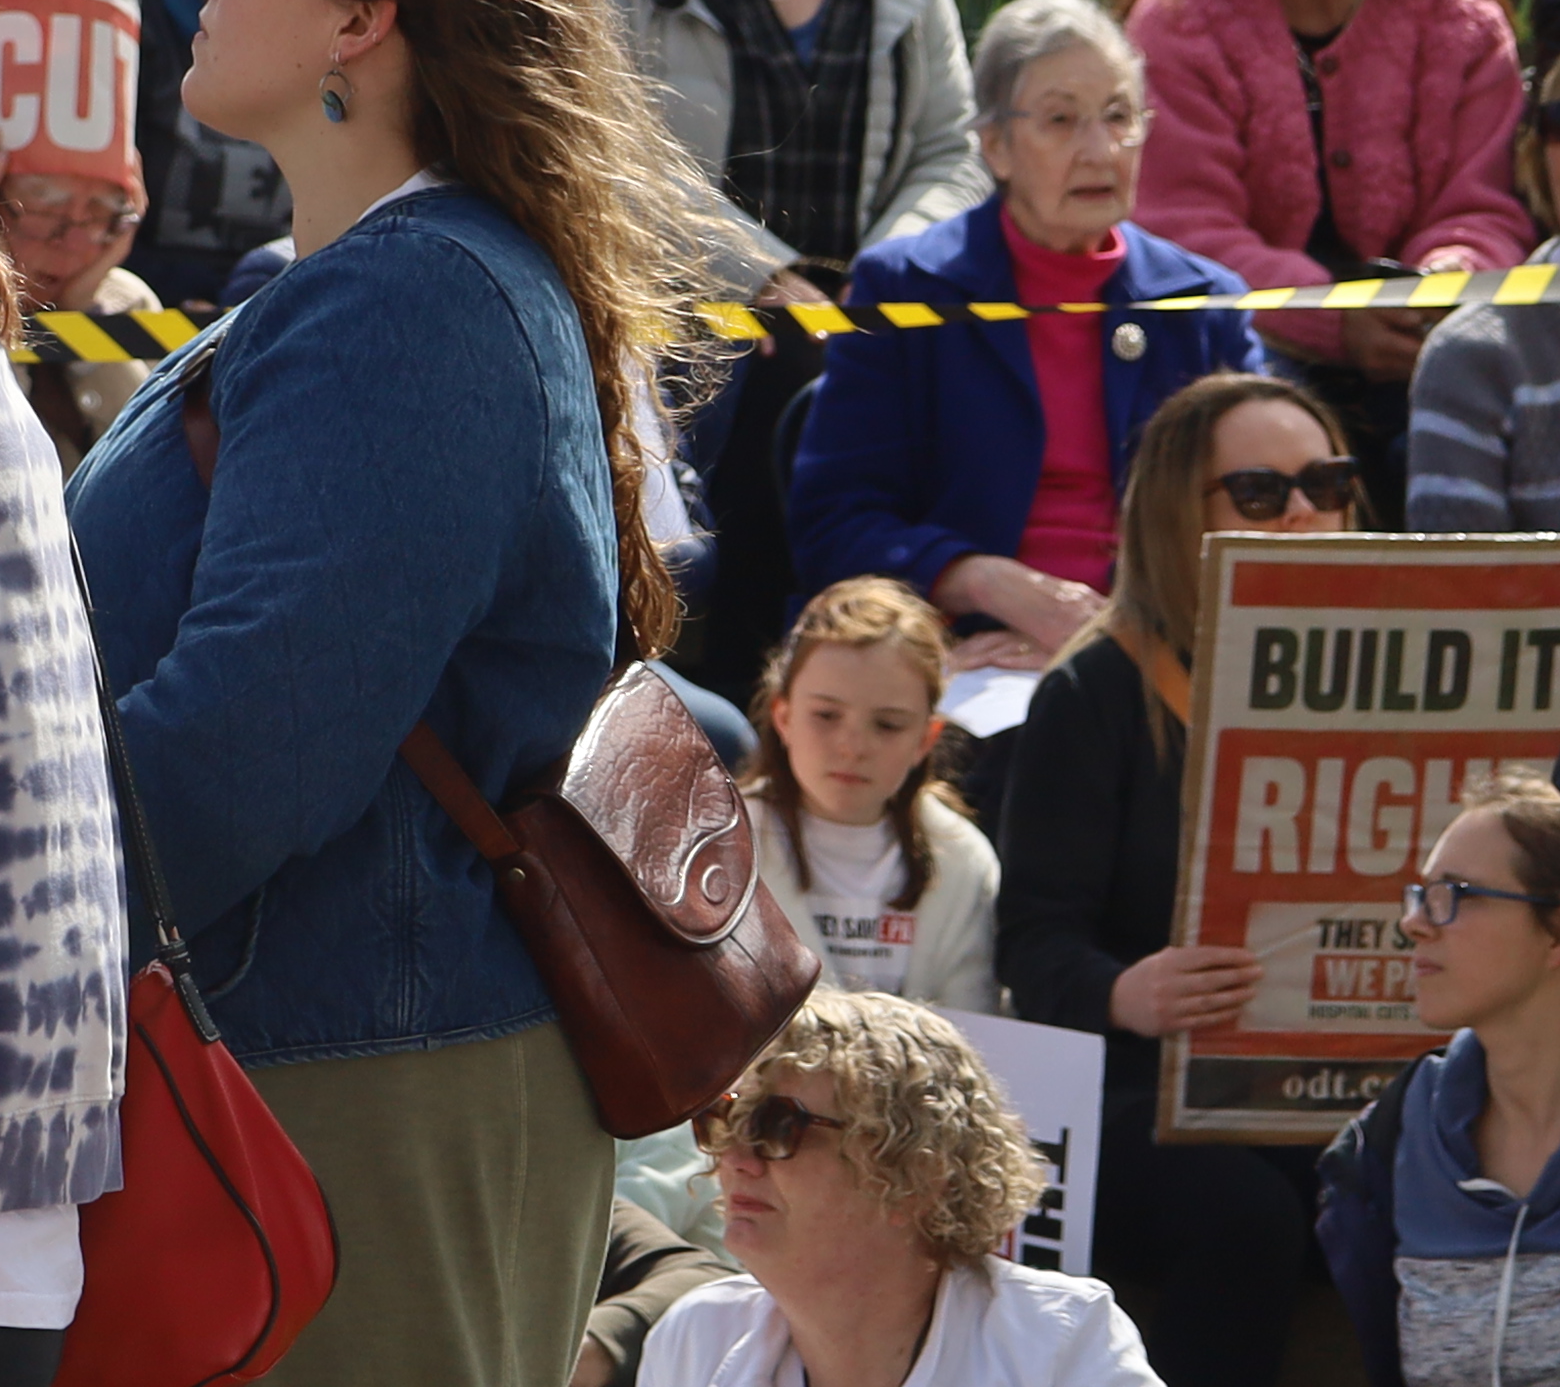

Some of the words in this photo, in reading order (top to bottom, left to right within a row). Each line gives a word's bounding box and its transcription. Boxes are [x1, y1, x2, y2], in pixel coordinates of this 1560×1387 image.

[1248, 627, 1472, 713] BUILD
[1233, 755, 1558, 877] RIGH
[1318, 919, 1386, 950] THEY
[1325, 958, 1379, 998] WE
[1282, 1068, 1399, 1100] odt.c
